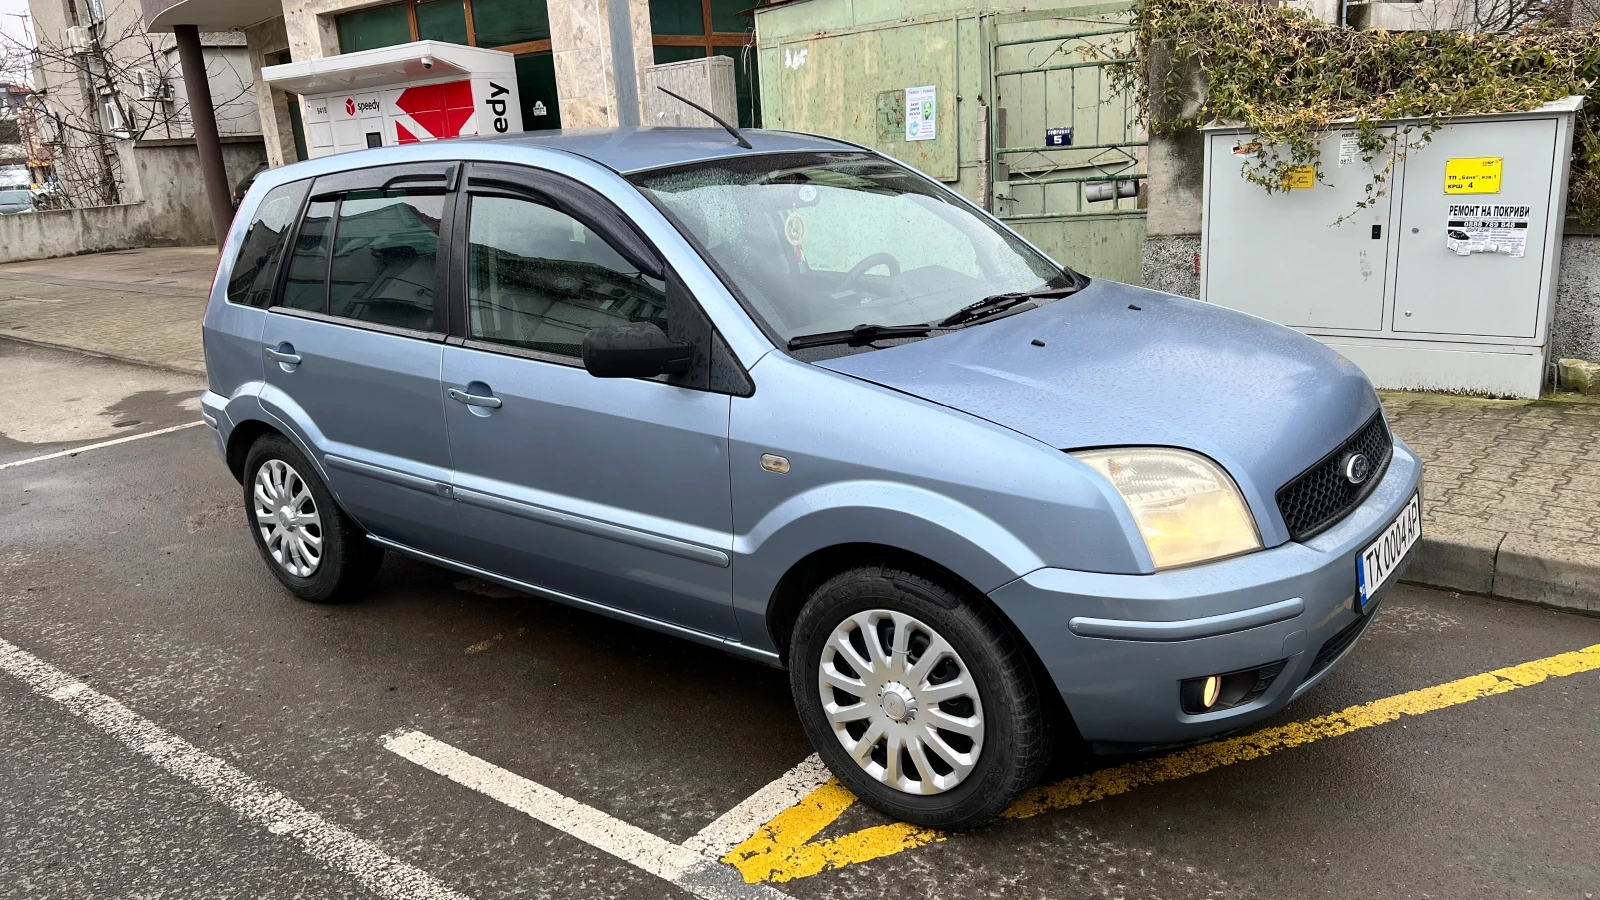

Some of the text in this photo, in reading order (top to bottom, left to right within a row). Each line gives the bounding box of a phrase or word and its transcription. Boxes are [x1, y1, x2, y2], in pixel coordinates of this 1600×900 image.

[357, 99, 380, 113] speedy
[1053, 135, 1062, 144] 5
[1449, 205, 1530, 217] РЕМОНТ НА ПОКРИВИ
[1365, 542, 1383, 589] TX
[1383, 515, 1407, 571] 0004
[1407, 501, 1418, 544] AP
